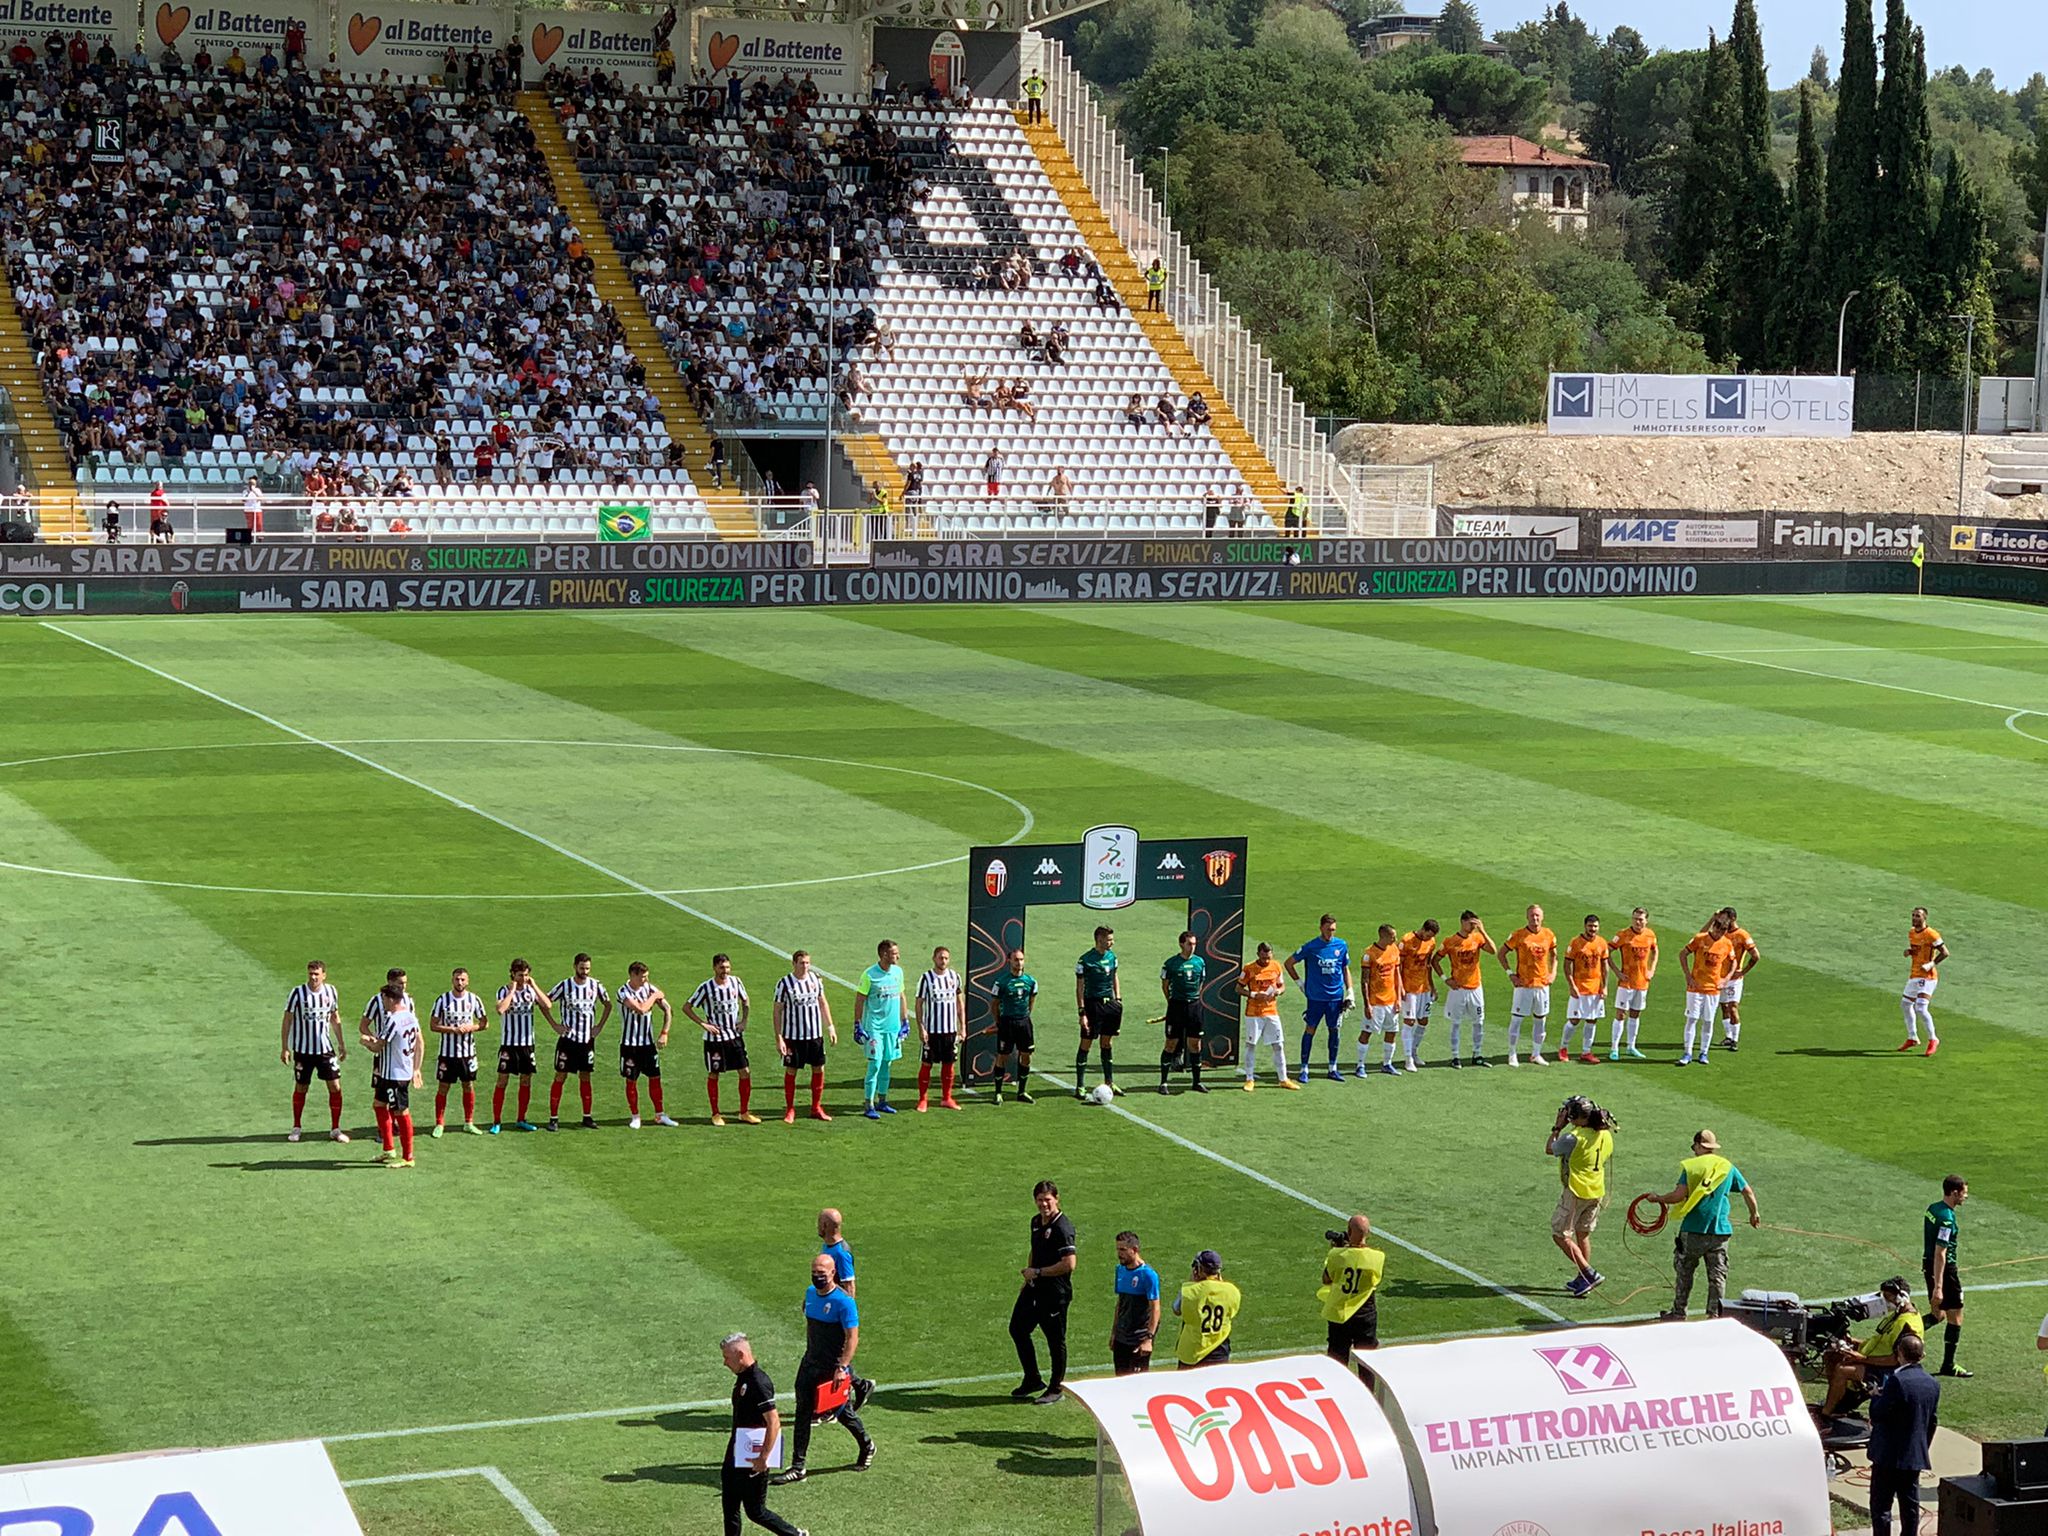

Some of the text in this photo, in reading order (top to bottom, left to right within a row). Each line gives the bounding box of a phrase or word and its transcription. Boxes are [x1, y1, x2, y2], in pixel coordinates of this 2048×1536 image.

[21, 0, 112, 25] Battente
[195, 9, 214, 30] al
[0, 29, 37, 38] ENTRO
[385, 19, 493, 44] al Battente
[567, 28, 655, 52] al Batten
[385, 48, 423, 57] CENTRO
[743, 37, 843, 61] al Battente
[567, 57, 604, 66] CENTRO
[1600, 377, 1639, 397] HM
[1752, 379, 1792, 399] HM
[1599, 398, 1698, 420] HOTELS
[1751, 400, 1850, 421] HOTELS
[1633, 424, 1767, 433] HMHOTELSERESORT.COM
[1466, 520, 1506, 532] TEAM
[1604, 520, 1680, 542] MAPE
[1774, 519, 1923, 555] Fainplast
[70, 547, 163, 573] SARA
[171, 547, 315, 573] SERVIZI
[328, 548, 409, 571] PRIVACY
[409, 557, 424, 571] &
[427, 548, 529, 571] SICUREZZA
[535, 545, 591, 571] PER
[601, 544, 626, 571] IL
[632, 543, 814, 570] CONDOMINIO
[927, 543, 1002, 567] SARA
[1010, 542, 1132, 566] SERVIZI
[1143, 543, 1212, 564] PRIVACY
[1212, 551, 1223, 565] &
[1318, 540, 1367, 564] PER
[1374, 540, 1394, 564] IL
[1401, 539, 1556, 563] CONDOMINIO
[300, 580, 389, 609] SARA
[397, 578, 537, 608] SERVIZI
[549, 578, 628, 604] PRIVACY
[628, 589, 642, 604] &
[645, 577, 745, 603] SICUREZZA
[750, 573, 805, 603] PER
[814, 573, 838, 602] IL
[845, 571, 1023, 601] CONDOMINIO
[1076, 572, 1153, 599] SARA
[1158, 571, 1279, 597] SERVIZI
[1289, 571, 1358, 595] PRIVACY
[1358, 581, 1370, 596] &
[1372, 570, 1457, 593] SICUREZZA
[1462, 567, 1509, 594] PER
[1516, 567, 1536, 593] IL
[1543, 565, 1697, 593] CONDOMINIO
[1098, 871, 1122, 881] Serie
[1090, 882, 1129, 898] BKT
[1342, 1267, 1362, 1294] 31
[1201, 1305, 1224, 1333] 28
[1425, 1386, 1794, 1454] ELETTROMARCHE AP
[1450, 1418, 1792, 1471] IMPIANTI ELETTRICI E TECNOLOGICI
